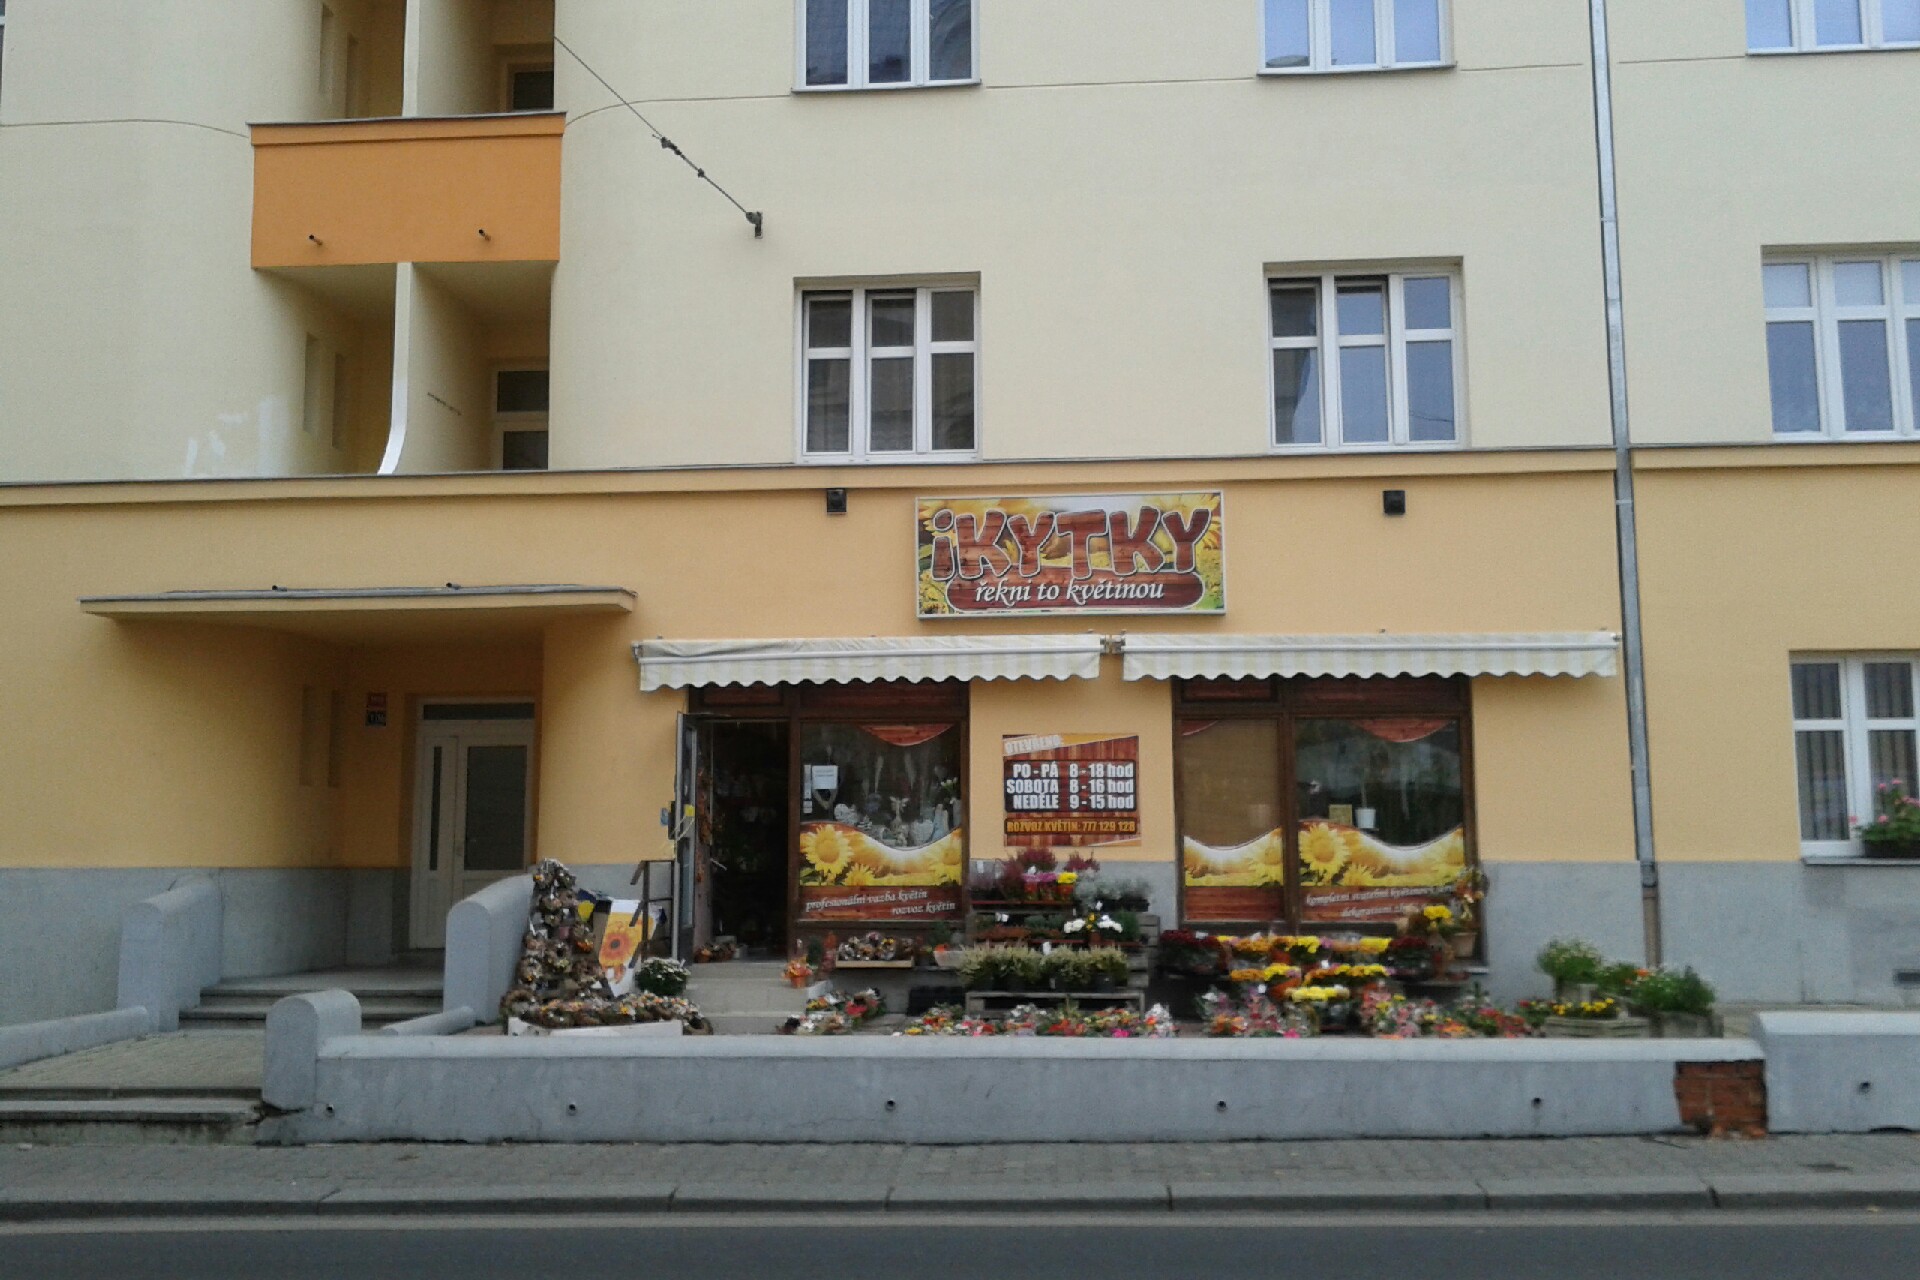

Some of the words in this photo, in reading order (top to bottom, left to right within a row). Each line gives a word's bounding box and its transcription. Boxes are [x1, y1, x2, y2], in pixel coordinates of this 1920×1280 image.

[976, 579, 1031, 606] řekni
[1037, 582, 1060, 601] to
[1066, 577, 1164, 606] květinou
[1012, 763, 1031, 778] PO
[1041, 761, 1059, 778] PÁ
[1069, 763, 1079, 778] 8
[1089, 763, 1104, 778] 18
[1107, 763, 1134, 778] hod
[1006, 779, 1059, 794] SOBOTA
[1069, 779, 1079, 793] 8
[1089, 779, 1105, 793] 16
[1107, 779, 1134, 793] hod
[1013, 792, 1059, 809] NEDĚLE
[1069, 794, 1080, 809] 9
[1089, 794, 1105, 809] 15
[1107, 794, 1134, 809] hod
[1006, 821, 1043, 832] ROZVOZ
[1082, 821, 1097, 832] 777
[1098, 821, 1116, 832] 129
[805, 894, 865, 912] profesionální
[898, 889, 928, 903] květin
[925, 900, 956, 914] květin
